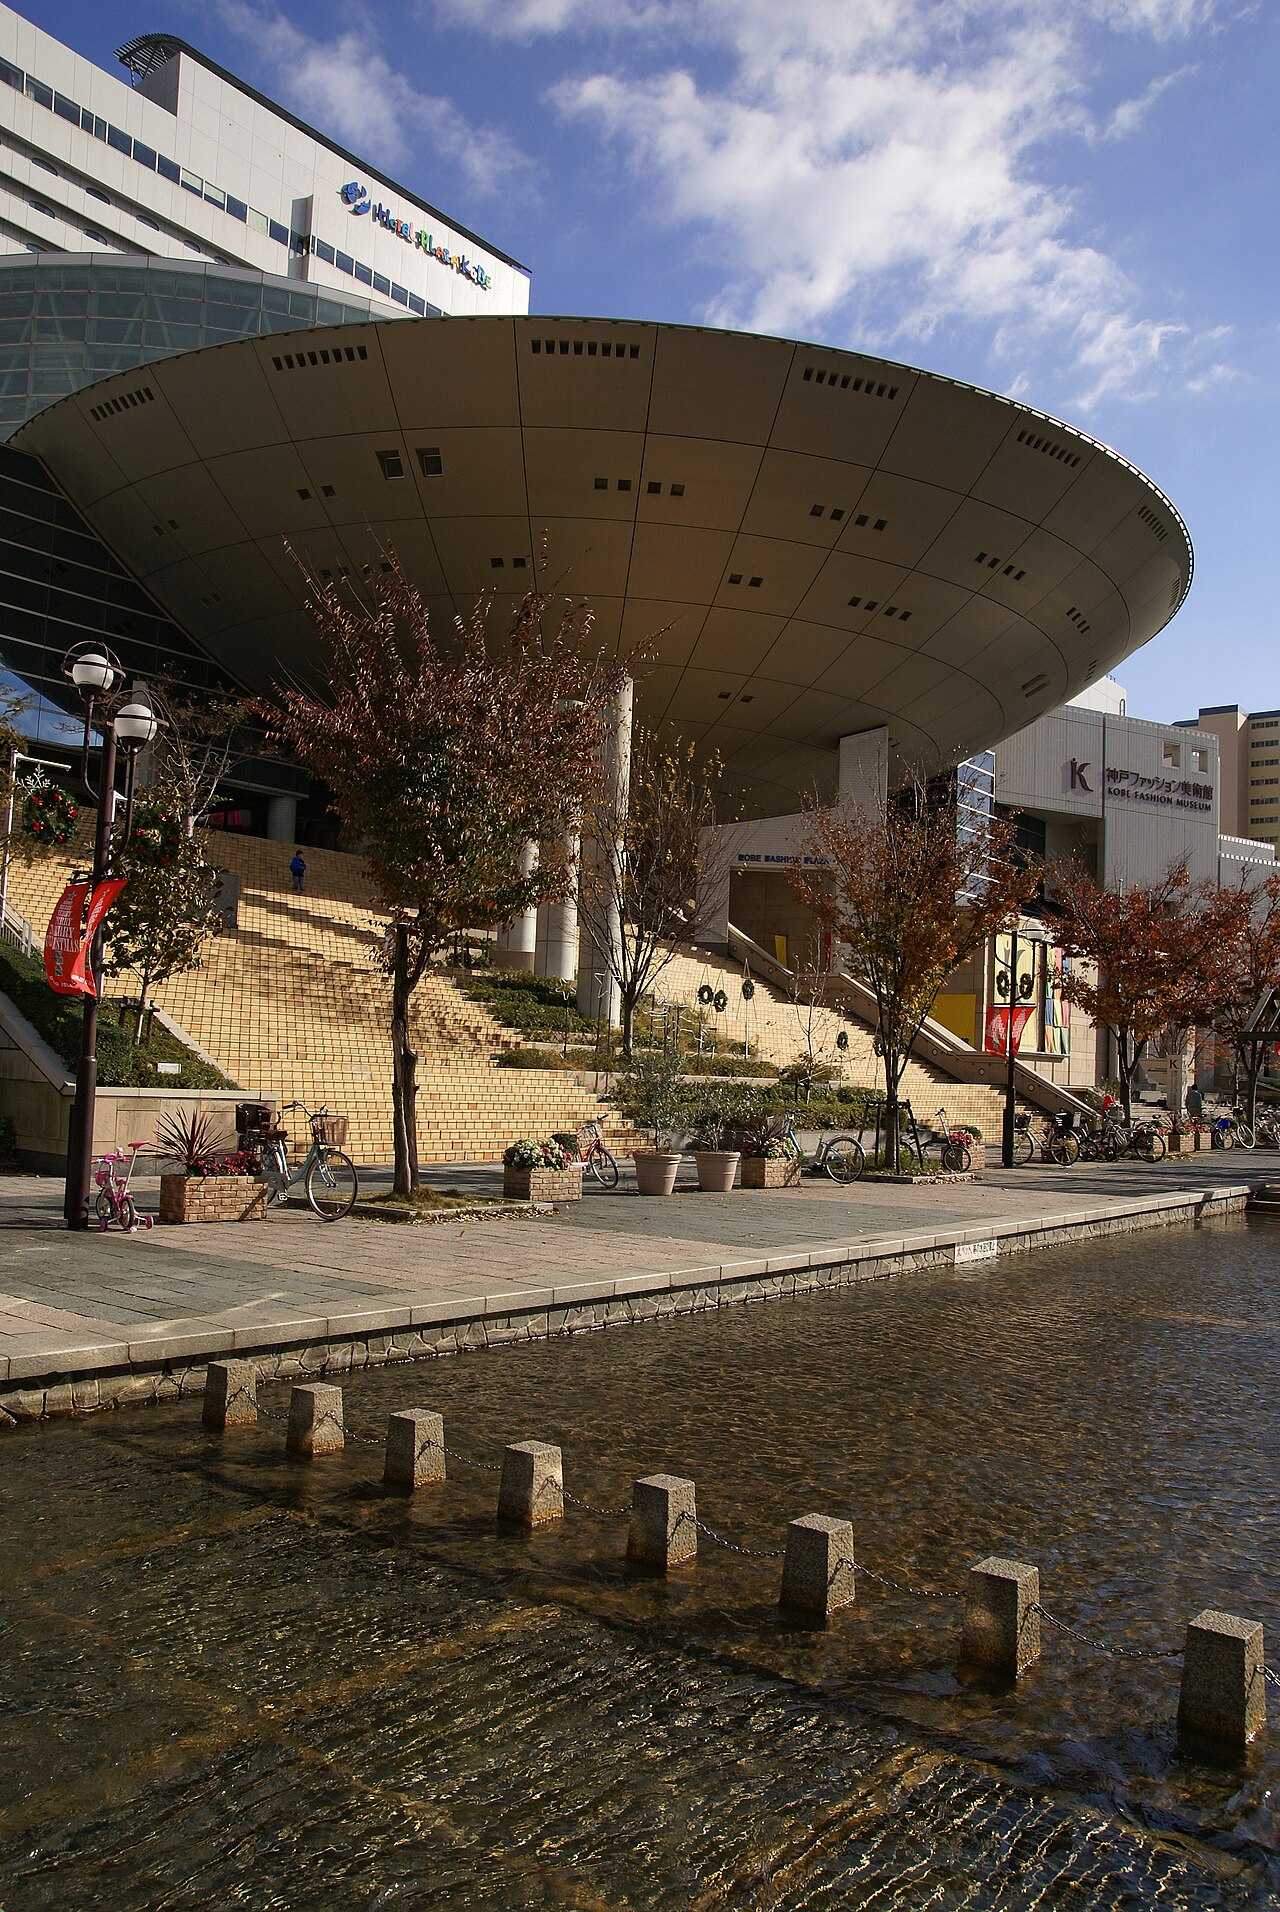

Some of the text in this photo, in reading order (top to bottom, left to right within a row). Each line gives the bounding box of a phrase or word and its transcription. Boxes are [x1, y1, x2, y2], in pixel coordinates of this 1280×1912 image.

[1070, 758, 1094, 792] K
[1106, 767, 1213, 801] 神戸ファッション美術館
[1108, 787, 1211, 811] KOBE FASHION MUSEUM
